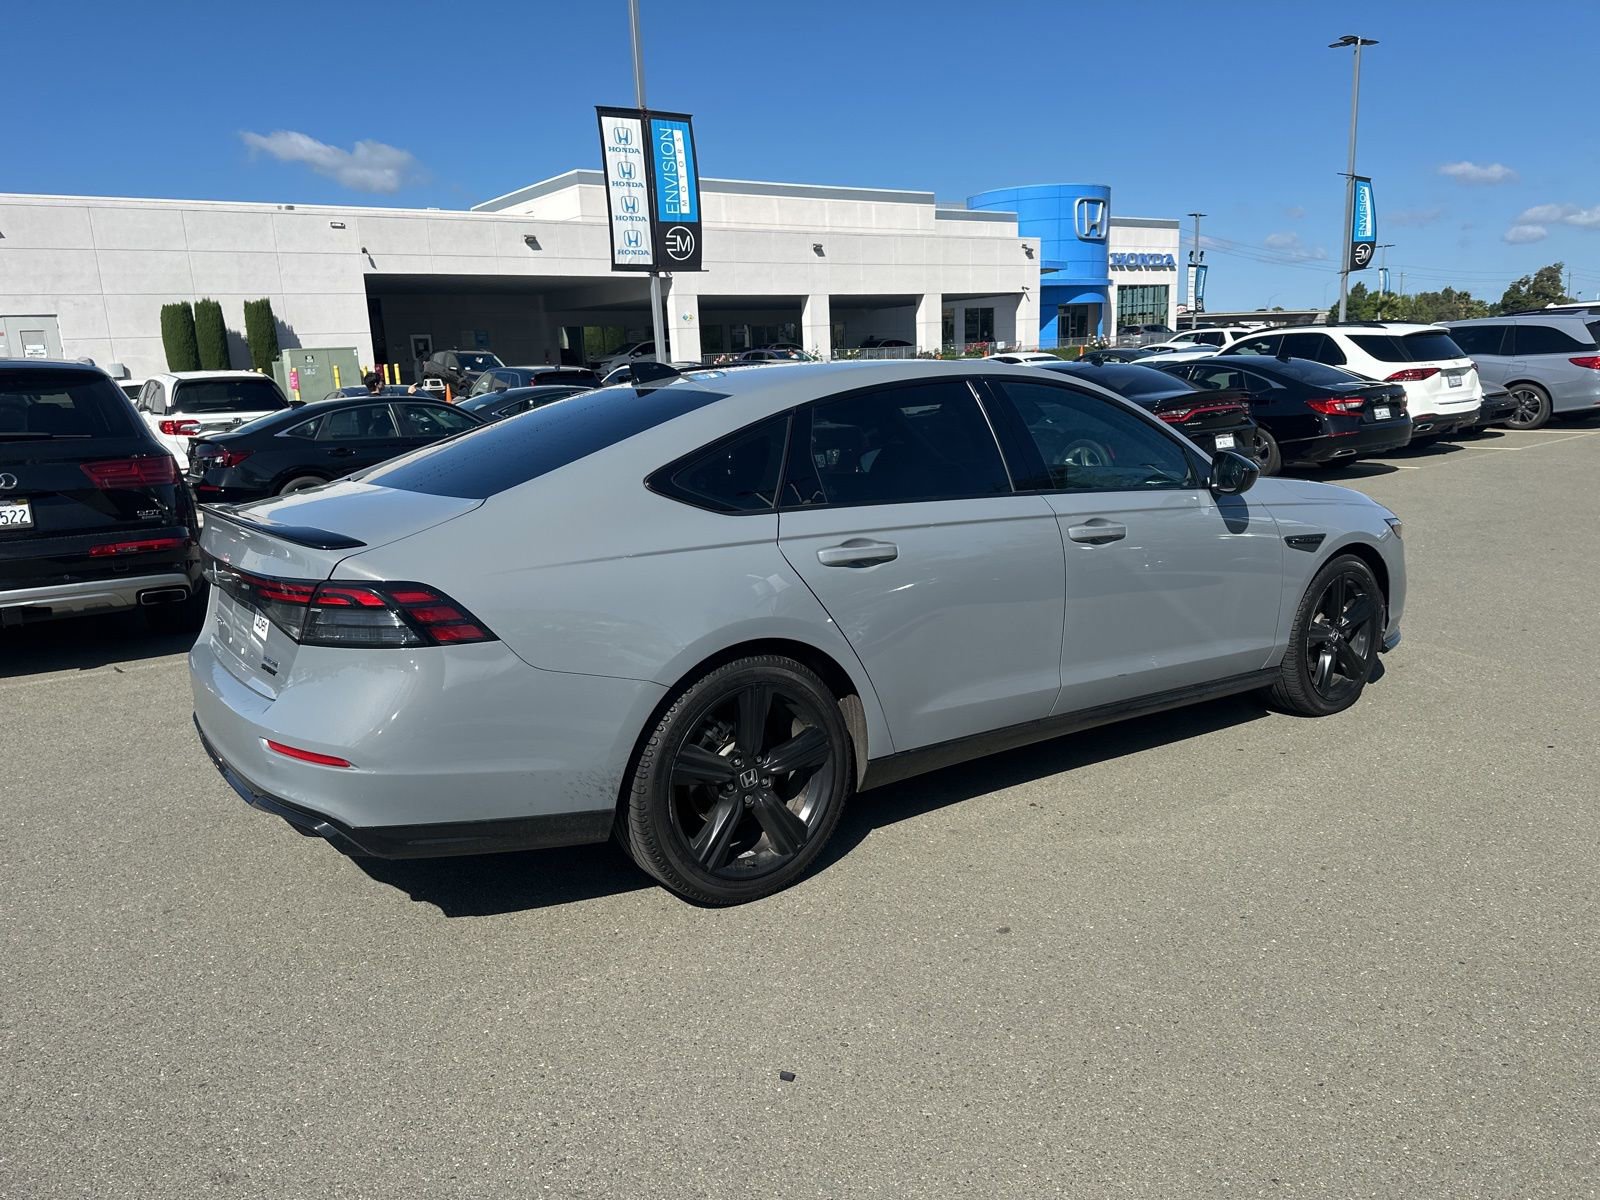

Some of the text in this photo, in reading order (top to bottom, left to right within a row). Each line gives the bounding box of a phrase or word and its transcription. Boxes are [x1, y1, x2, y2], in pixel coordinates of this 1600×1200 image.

[608, 146, 641, 154] HONDA
[659, 127, 680, 214] ENVISION
[676, 137, 688, 207] MOTORS
[612, 180, 645, 188] HONDA
[615, 214, 648, 222] HONDA
[1358, 185, 1368, 237] ENVISION
[1109, 252, 1177, 268] HONDA
[0, 509, 28, 525] 522
